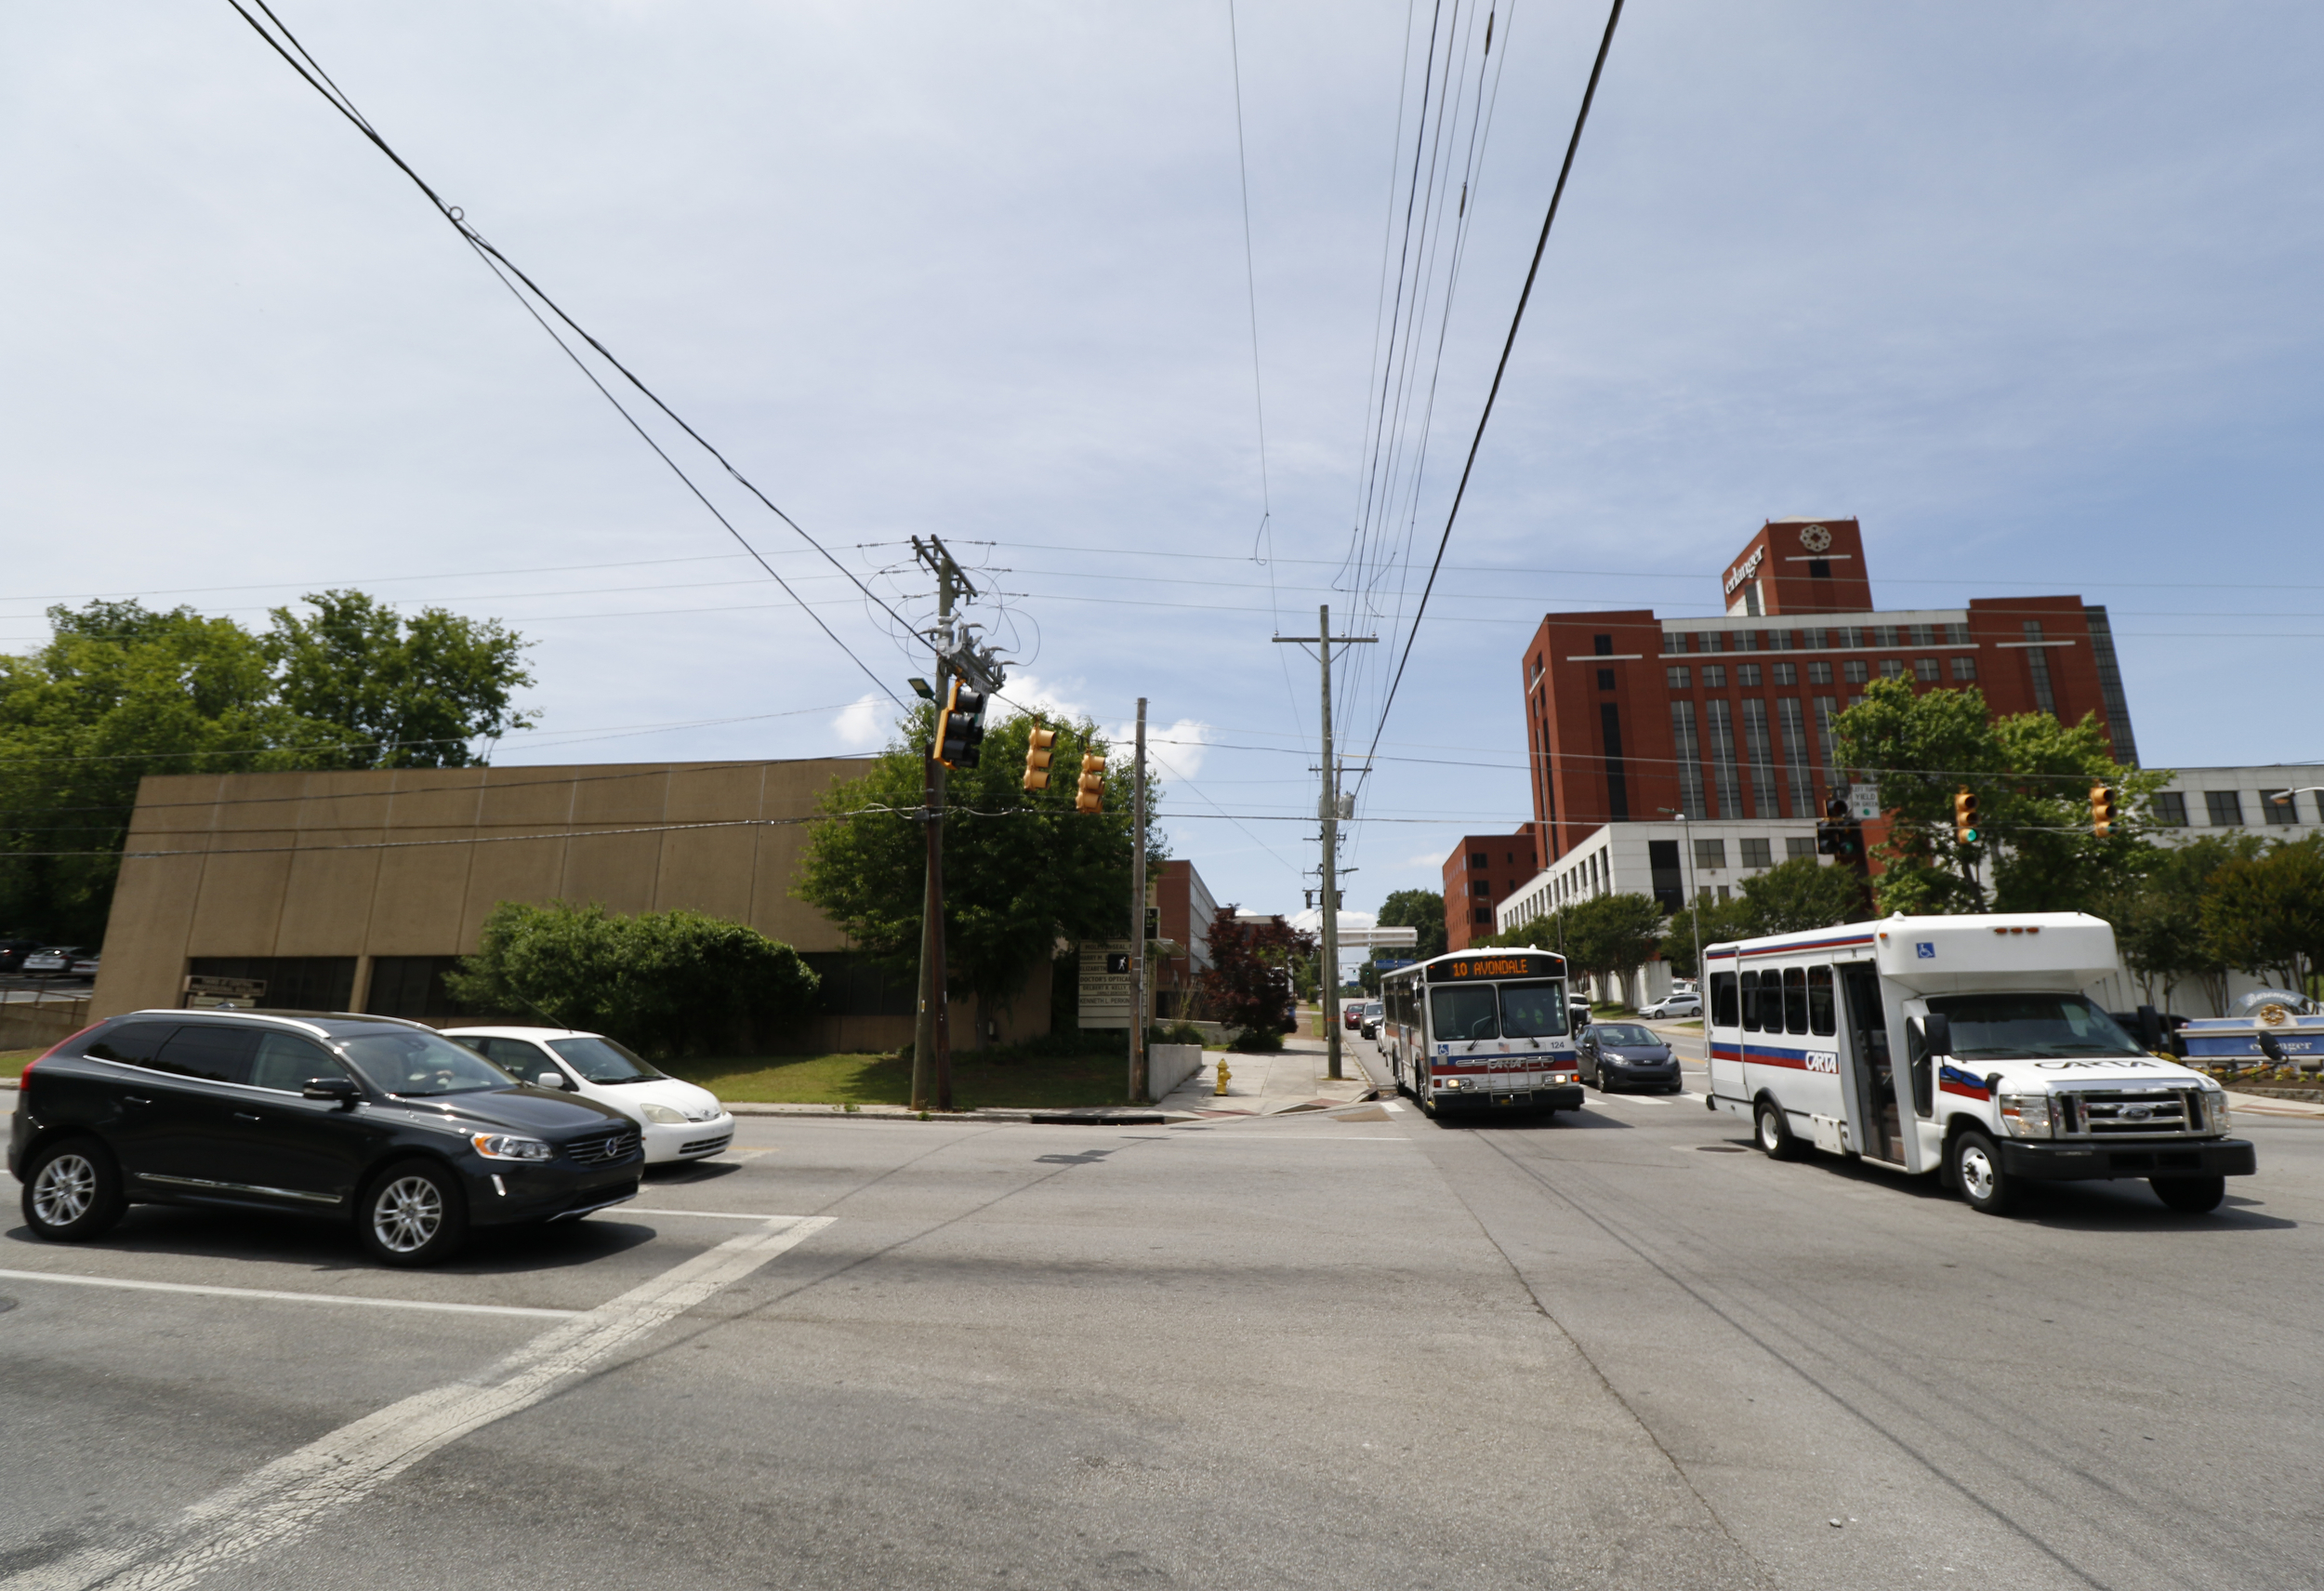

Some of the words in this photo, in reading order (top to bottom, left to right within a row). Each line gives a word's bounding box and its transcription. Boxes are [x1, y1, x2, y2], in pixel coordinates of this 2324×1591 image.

[1725, 544, 1764, 595] erlanger
[1453, 962, 1468, 976] 10
[1473, 959, 1528, 975] AVONDALE
[2247, 992, 2296, 1006] Baroness
[1805, 1051, 1837, 1073] CARTA
[2034, 1060, 2159, 1069] CARTA
[2130, 1109, 2146, 1118] Ford
